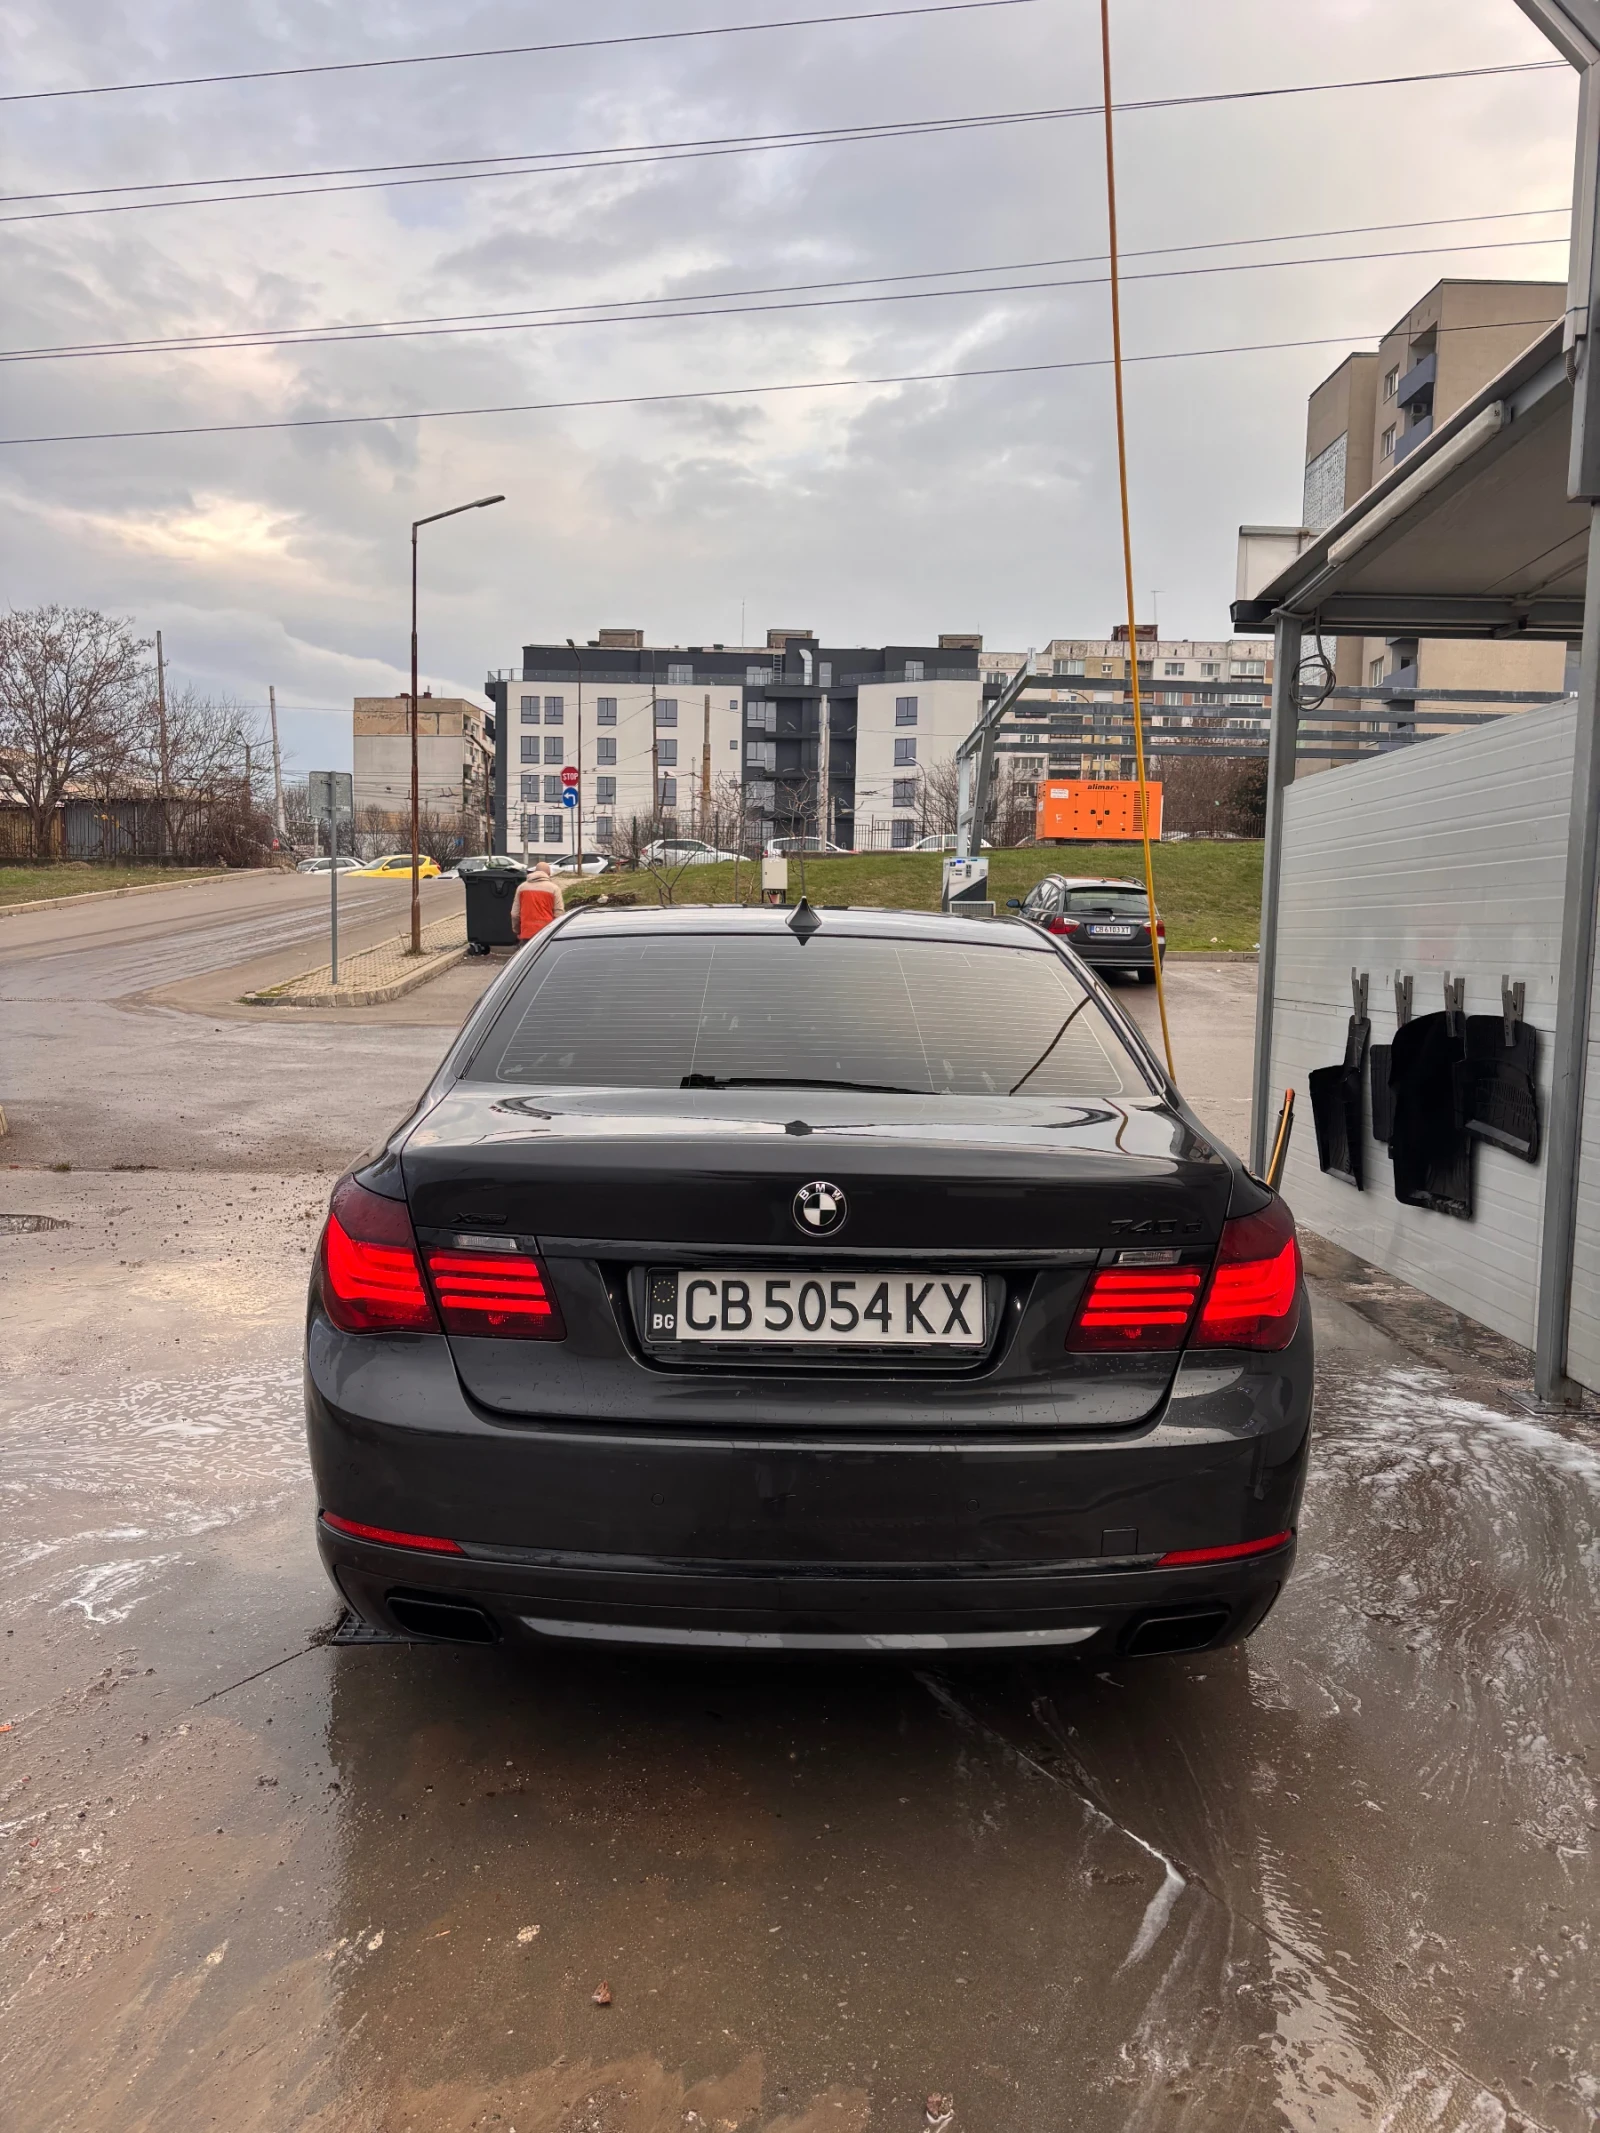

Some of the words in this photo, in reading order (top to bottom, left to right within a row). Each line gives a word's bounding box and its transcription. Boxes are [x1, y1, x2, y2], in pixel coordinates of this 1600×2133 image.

[798, 1183, 843, 1201] BMW
[685, 1280, 752, 1331] CB
[764, 1280, 892, 1333] 5054
[905, 1282, 972, 1335] KX
[652, 1313, 674, 1330] BG
